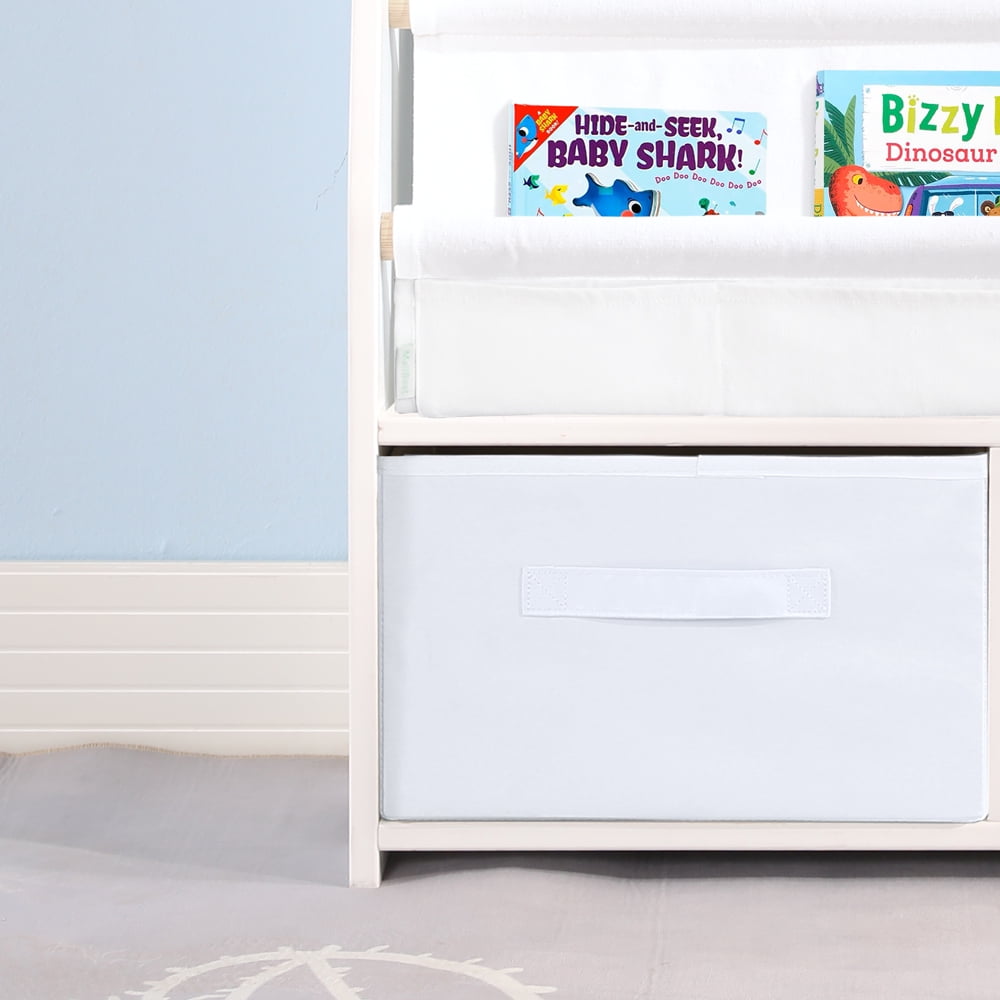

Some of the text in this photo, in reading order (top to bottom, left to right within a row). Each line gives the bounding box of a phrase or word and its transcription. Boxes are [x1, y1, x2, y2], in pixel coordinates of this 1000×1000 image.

[882, 93, 984, 142] Bizzy
[547, 138, 743, 172] BABY SHARK!
[885, 142, 997, 163] Dinosaur
[655, 175, 671, 184] Doo
[692, 173, 707, 183] Doo
[709, 177, 725, 188] Doo
[728, 181, 744, 190] Doo
[746, 179, 762, 189] Doo
